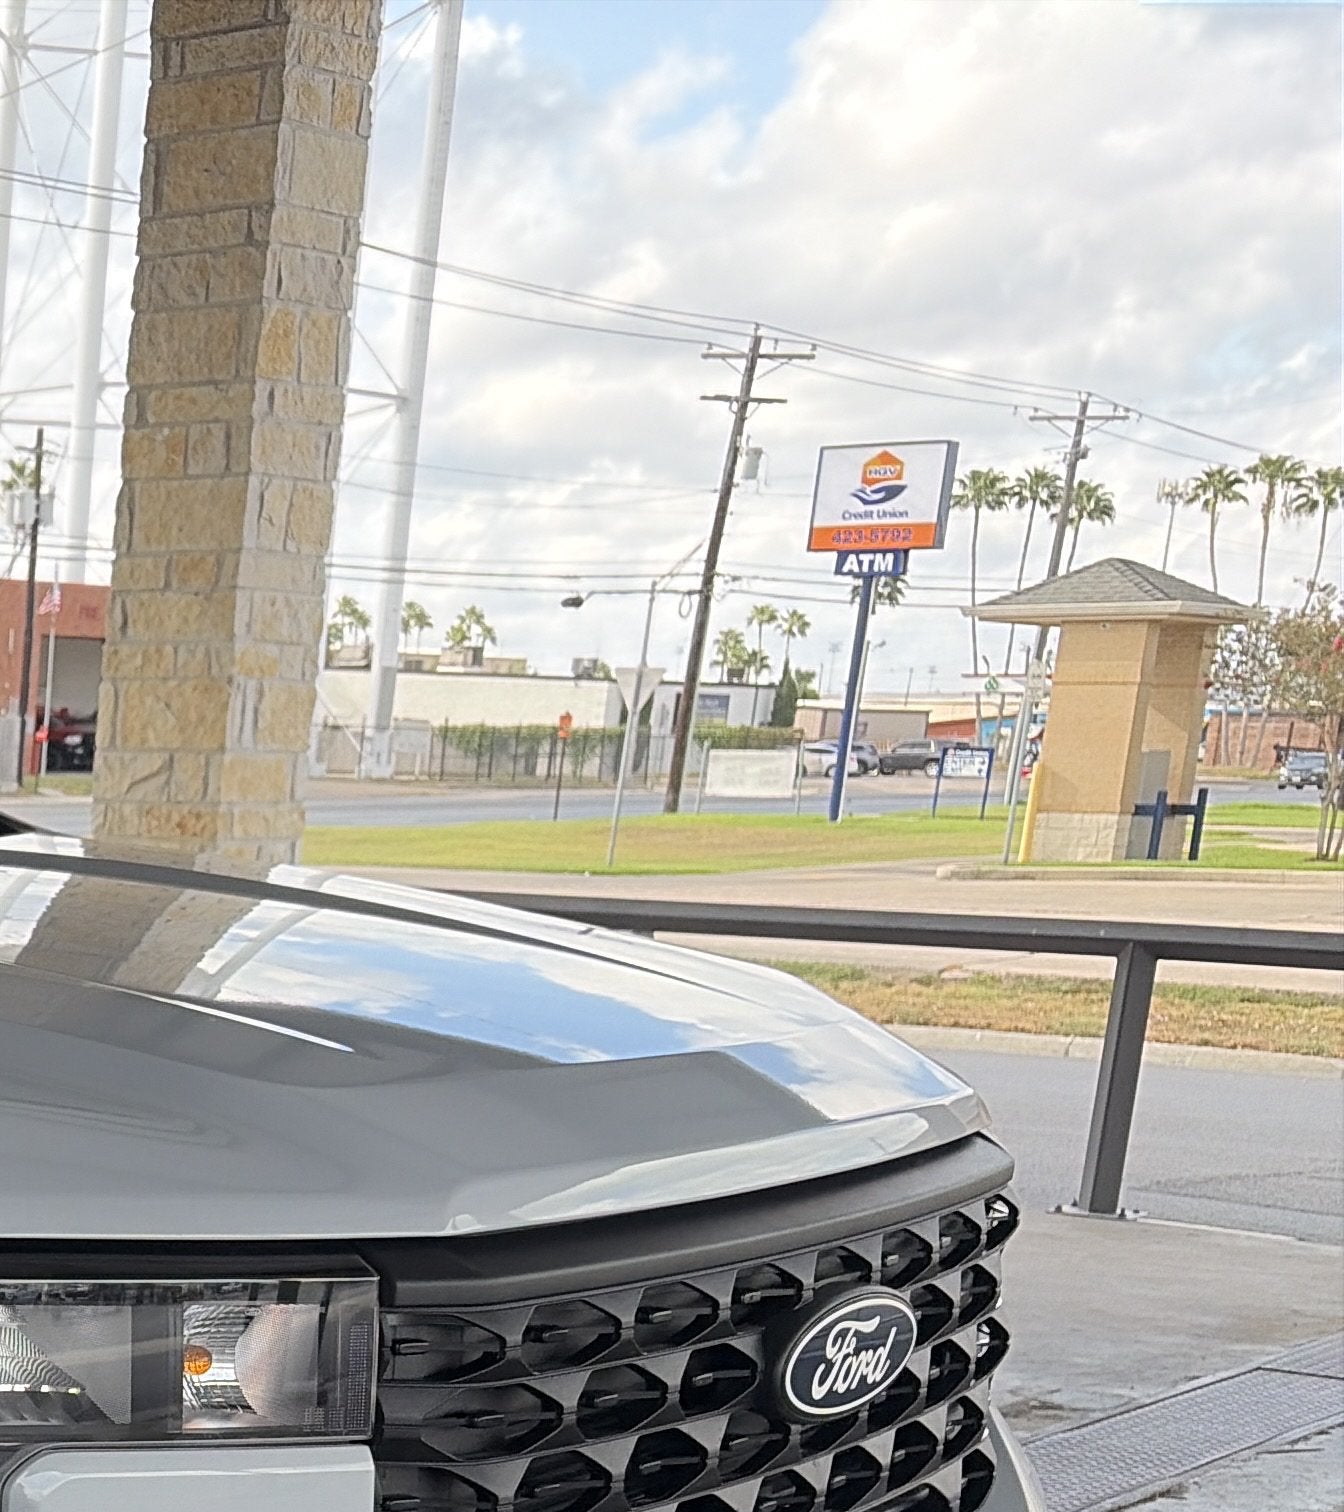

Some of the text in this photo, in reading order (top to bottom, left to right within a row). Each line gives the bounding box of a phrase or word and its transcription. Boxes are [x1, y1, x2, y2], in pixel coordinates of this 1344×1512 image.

[841, 507, 909, 521] Credit Union
[841, 552, 895, 573] ATM
[811, 1314, 898, 1401] Ford
